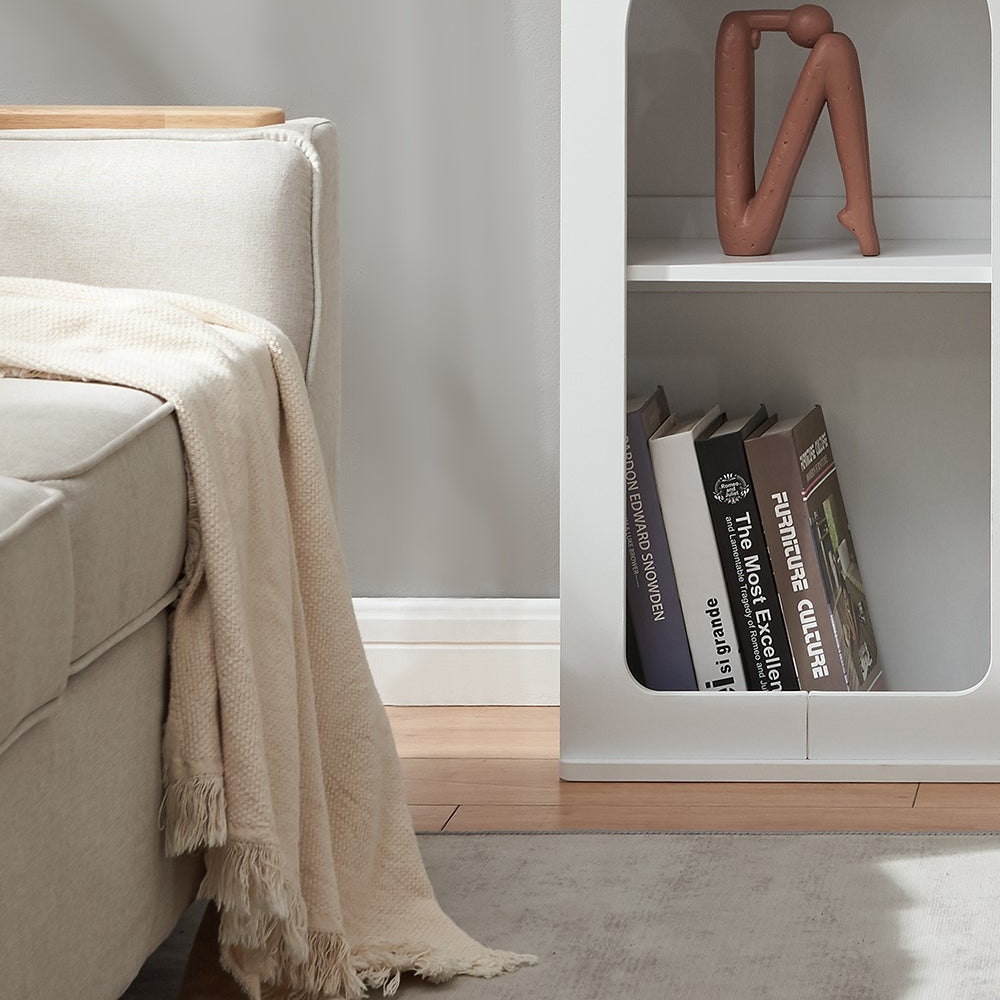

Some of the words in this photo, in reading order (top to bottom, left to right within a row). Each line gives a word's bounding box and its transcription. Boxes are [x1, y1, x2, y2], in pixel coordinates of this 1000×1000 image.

[725, 516, 735, 532] and
[735, 511, 753, 550] The
[629, 493, 651, 551] EDWARD
[641, 553, 666, 622] SNOWDEN
[729, 533, 745, 582] Lamentable
[743, 554, 767, 605] Most
[740, 584, 754, 618] Tragedy
[705, 597, 732, 655] grande
[747, 619, 755, 629] of
[797, 599, 829, 679] CULTURE
[749, 630, 761, 660] Romeo
[715, 659, 732, 674] si
[756, 662, 766, 679] and
